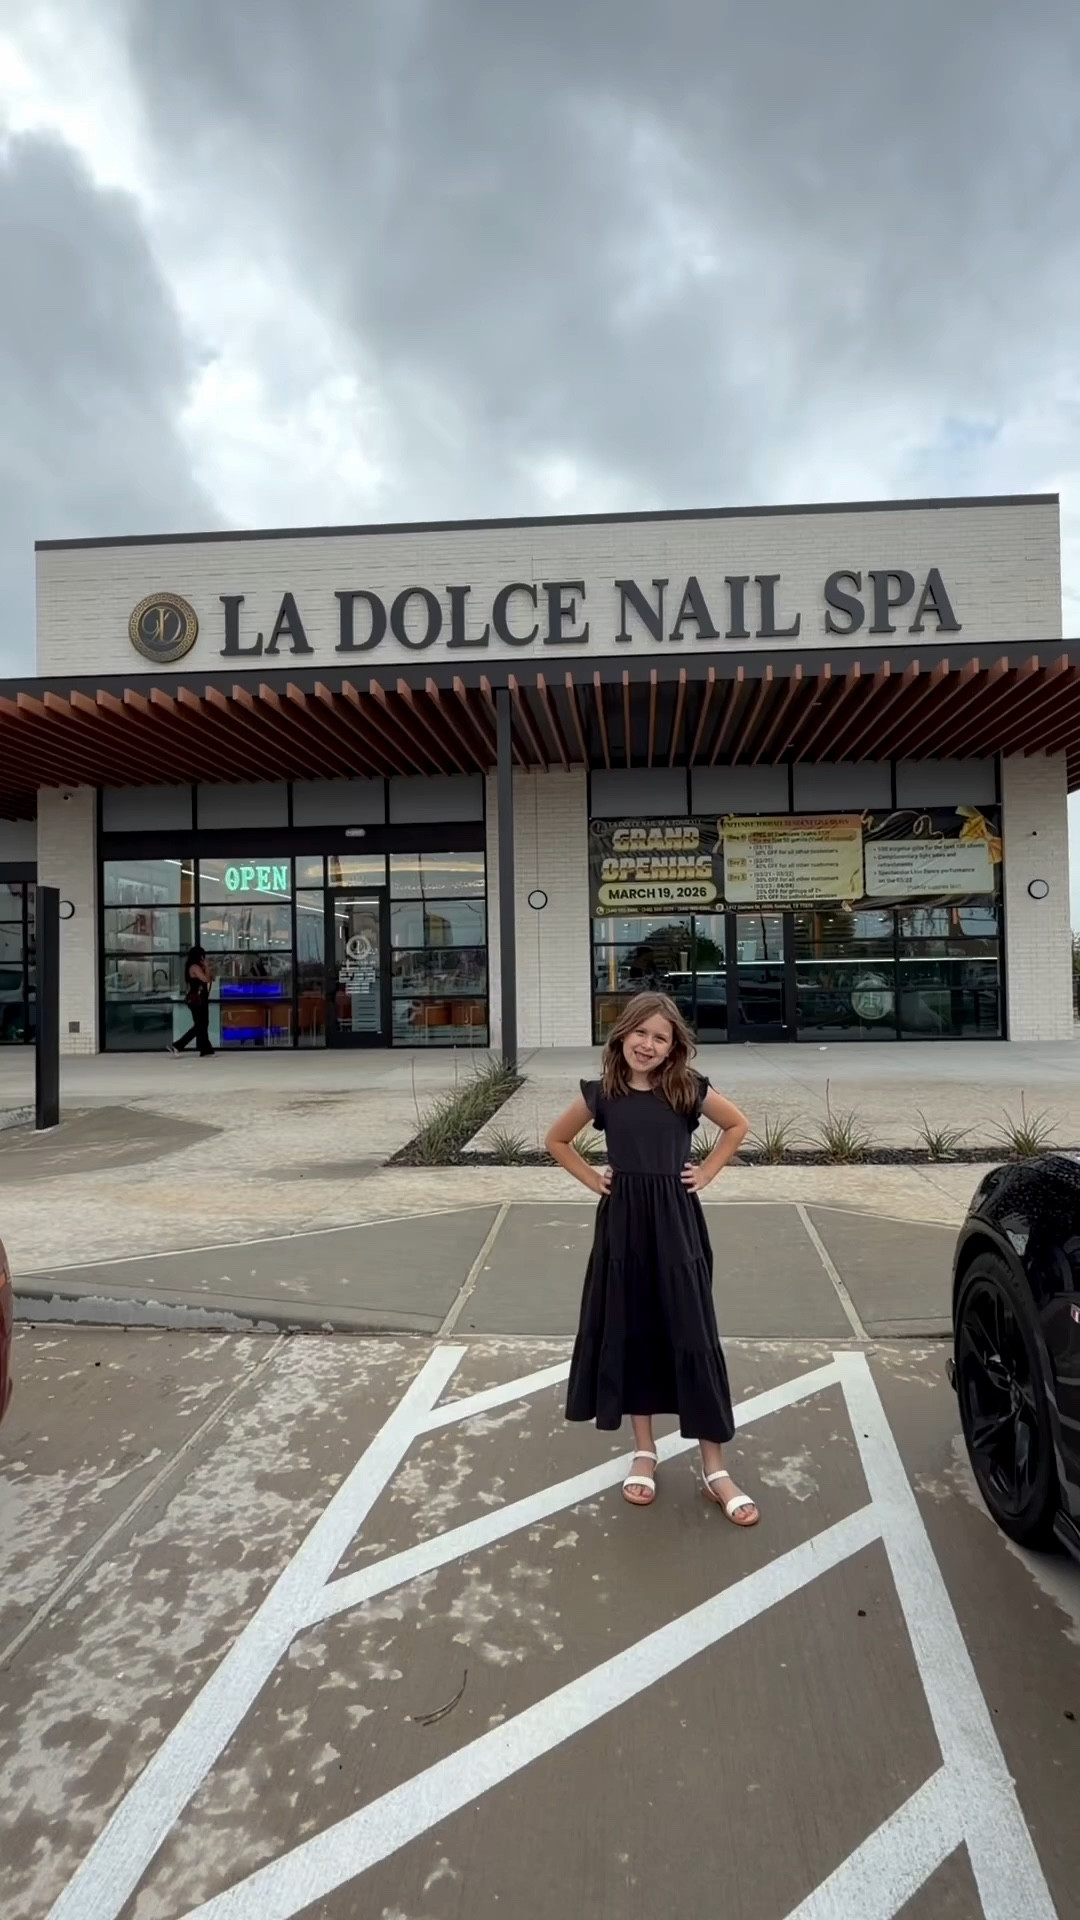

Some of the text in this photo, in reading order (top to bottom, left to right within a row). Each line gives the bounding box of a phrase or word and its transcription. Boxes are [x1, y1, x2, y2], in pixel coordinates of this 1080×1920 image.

[219, 567, 963, 656] LA DOLCE NAIL SPA
[612, 826, 700, 852] GRAND
[225, 865, 288, 891] OPEN
[601, 855, 713, 881] OPENING
[608, 886, 707, 900] MARCH 19, 2026
